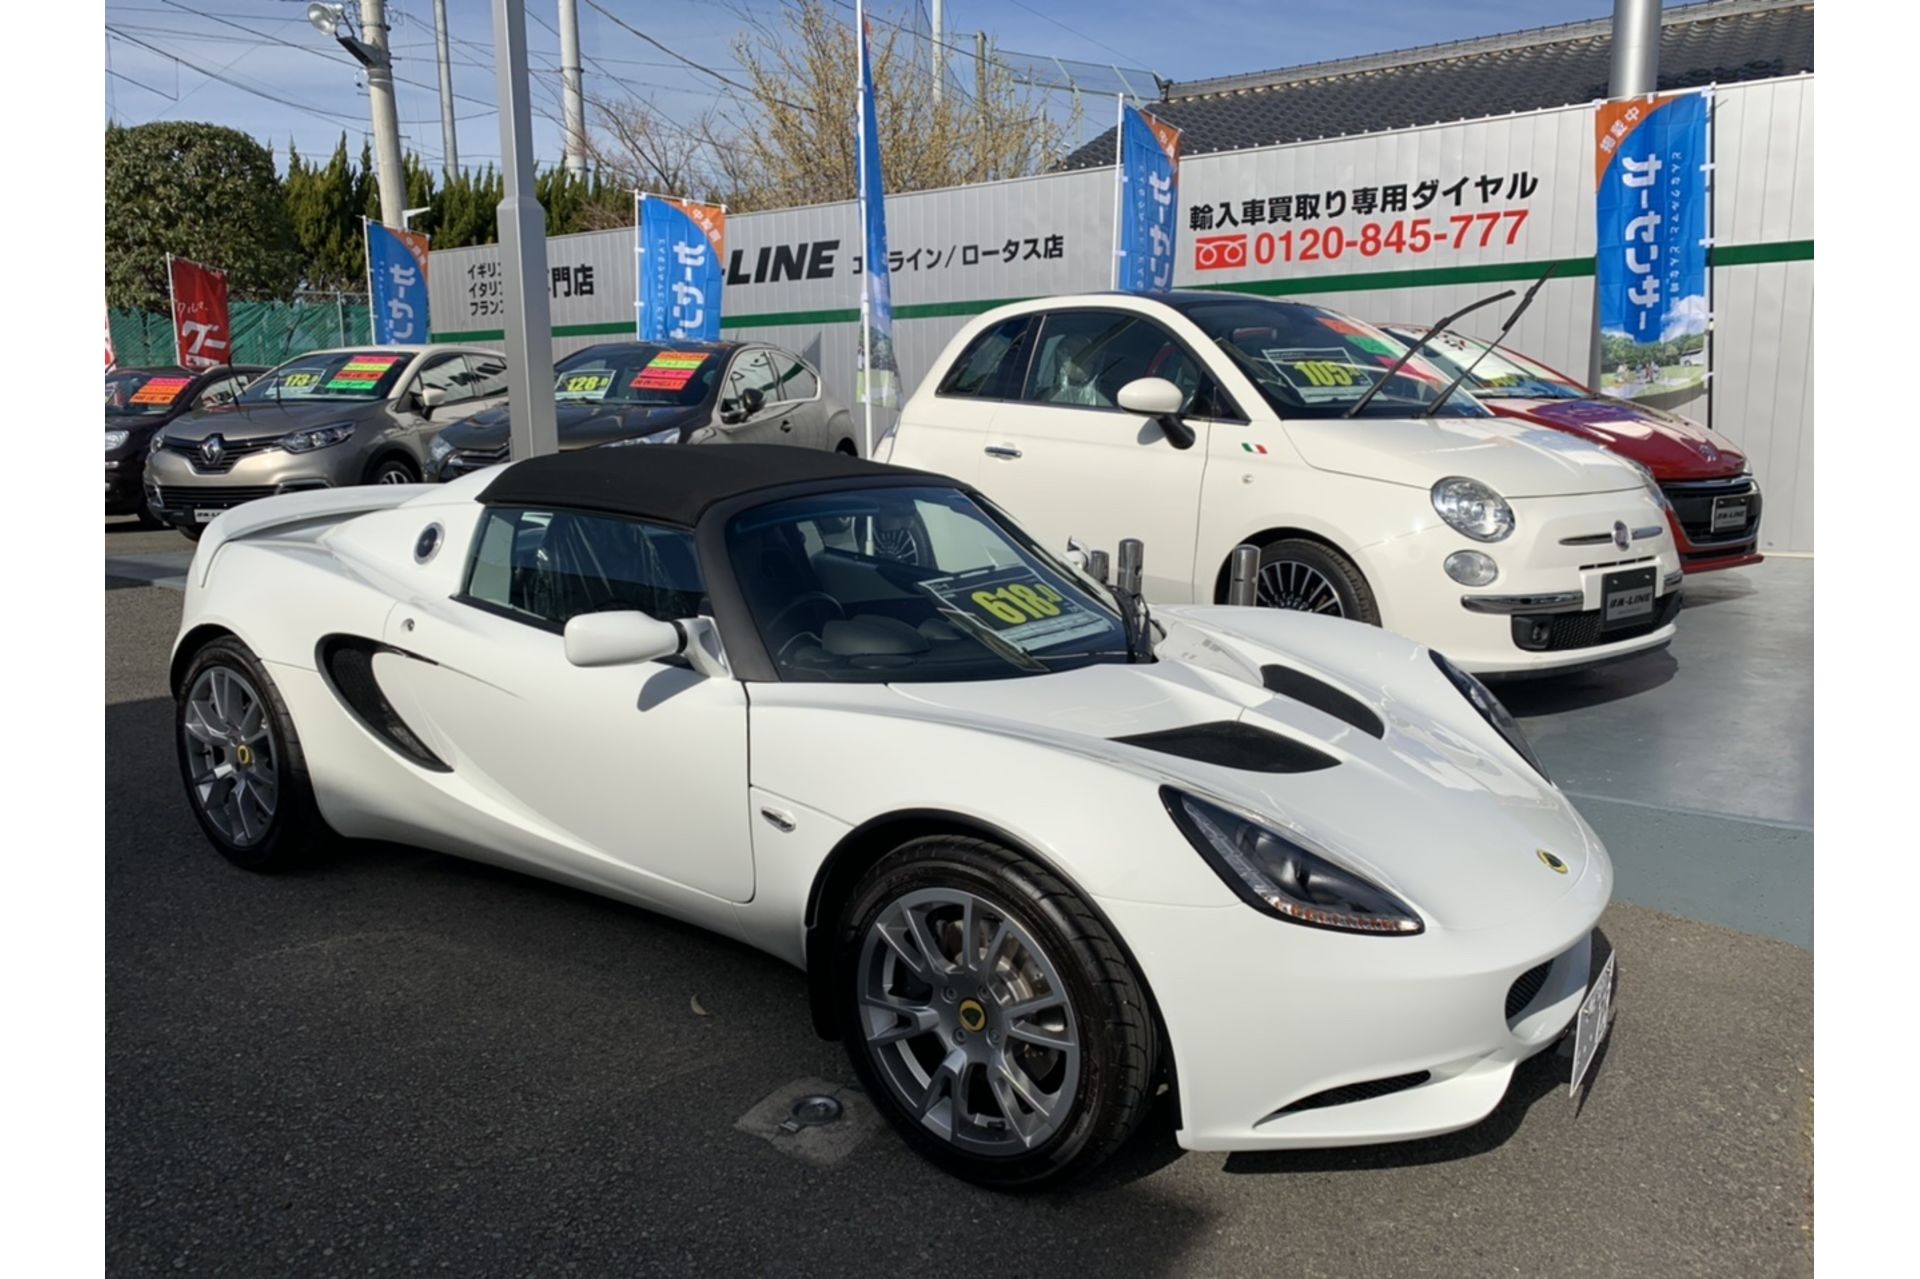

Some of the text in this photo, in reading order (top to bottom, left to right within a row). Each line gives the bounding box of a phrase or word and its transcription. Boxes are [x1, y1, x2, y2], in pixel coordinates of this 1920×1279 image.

[1189, 170, 1539, 232] 輸入車買取り専用ダイヤル
[852, 234, 1064, 275] エライン/ロータス店
[1253, 208, 1529, 265] 0120-845-777
[1622, 154, 1663, 330] カーセンサー
[467, 261, 502, 280] イギリ
[468, 280, 504, 298] イタリ
[547, 264, 594, 298] 門店
[469, 300, 505, 317] フラン
[970, 583, 1063, 625] 618.0
